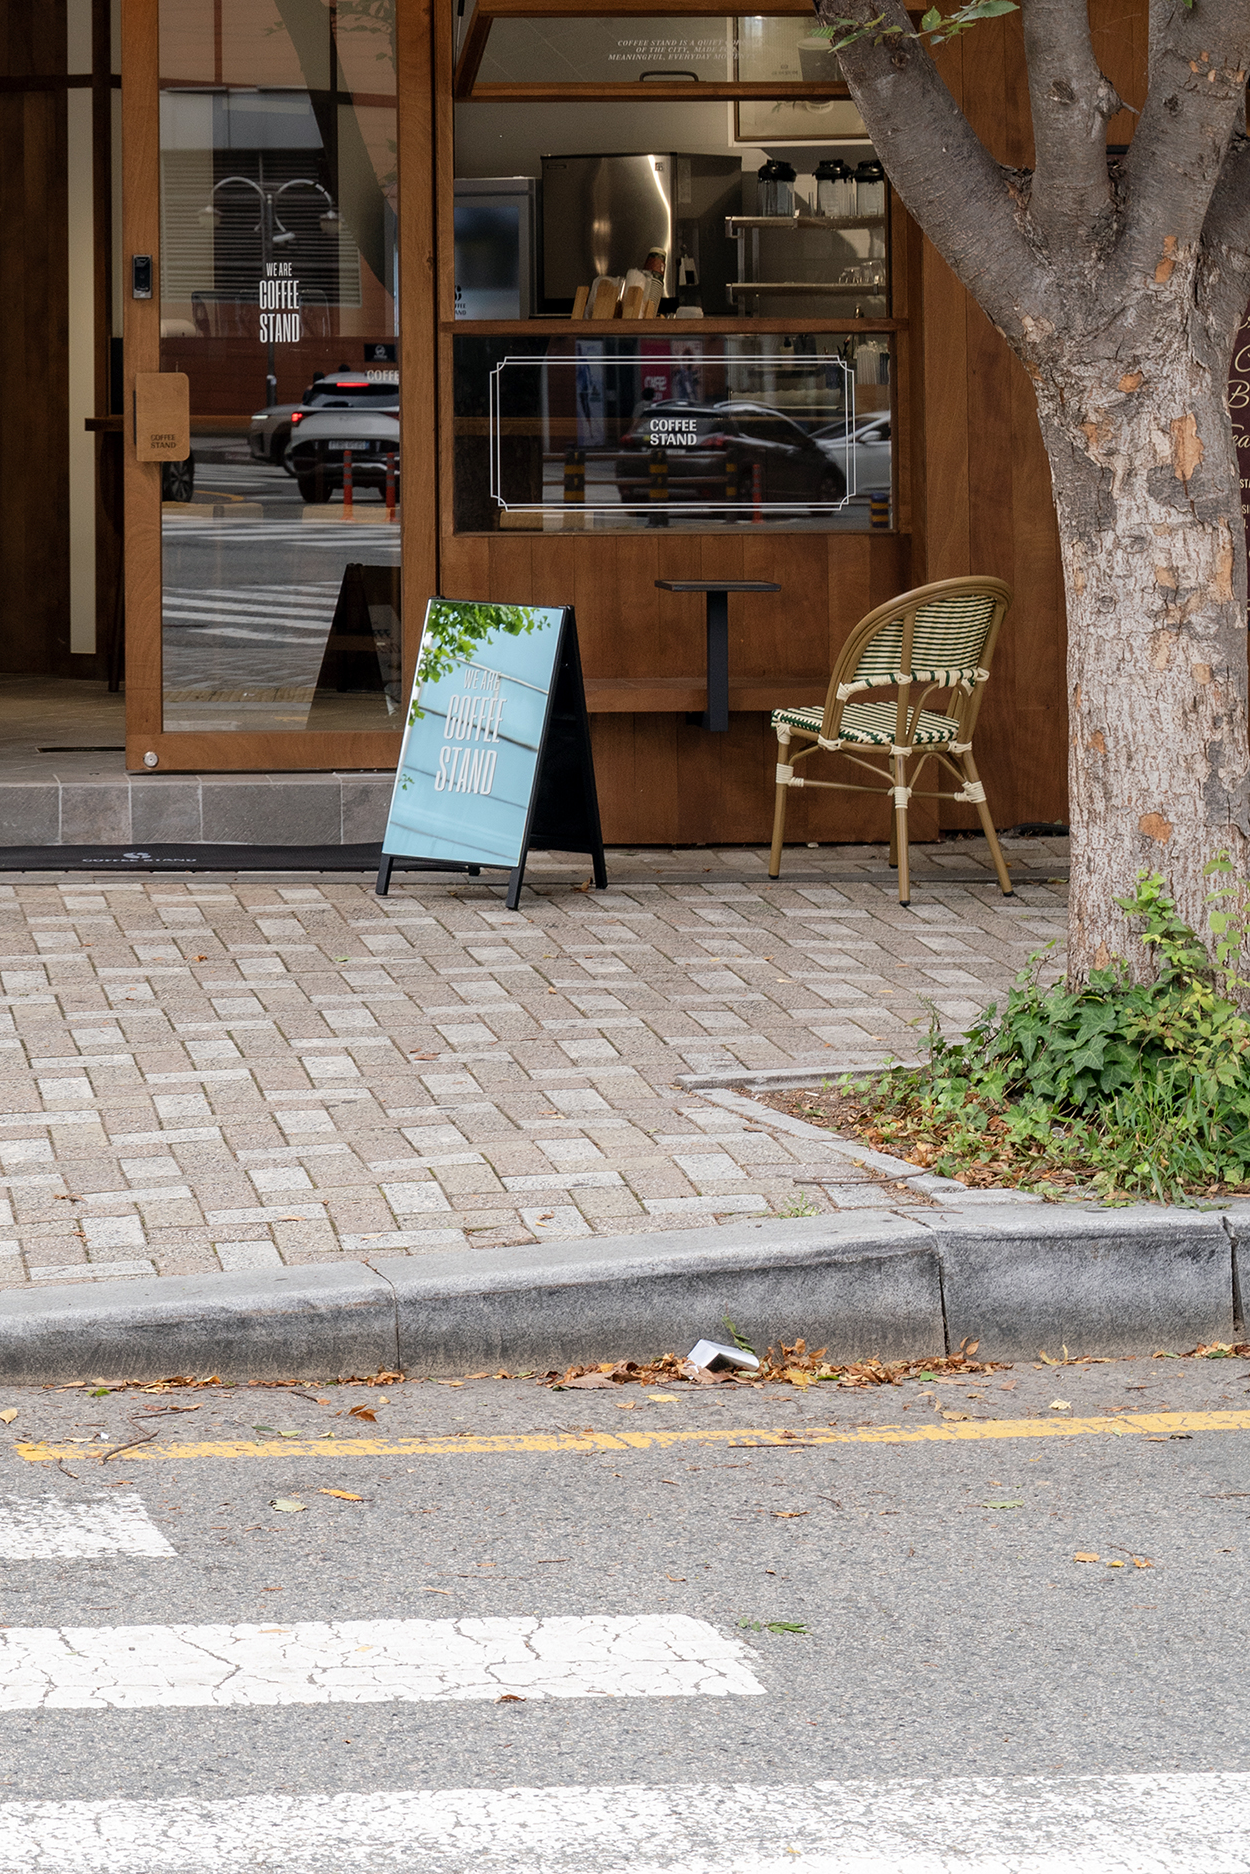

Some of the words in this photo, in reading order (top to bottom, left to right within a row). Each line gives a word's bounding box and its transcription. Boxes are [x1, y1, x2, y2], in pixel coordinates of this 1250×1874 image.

[266, 262, 279, 277] WE
[279, 262, 292, 277] ARE
[259, 280, 300, 309] COFFEE
[259, 313, 300, 343] STAND
[650, 419, 697, 432] COFFEE
[650, 433, 697, 446] STAND
[463, 668, 479, 690] WE
[480, 671, 501, 691] ARE
[443, 694, 508, 744] COFFEE
[434, 746, 498, 796] STAND
